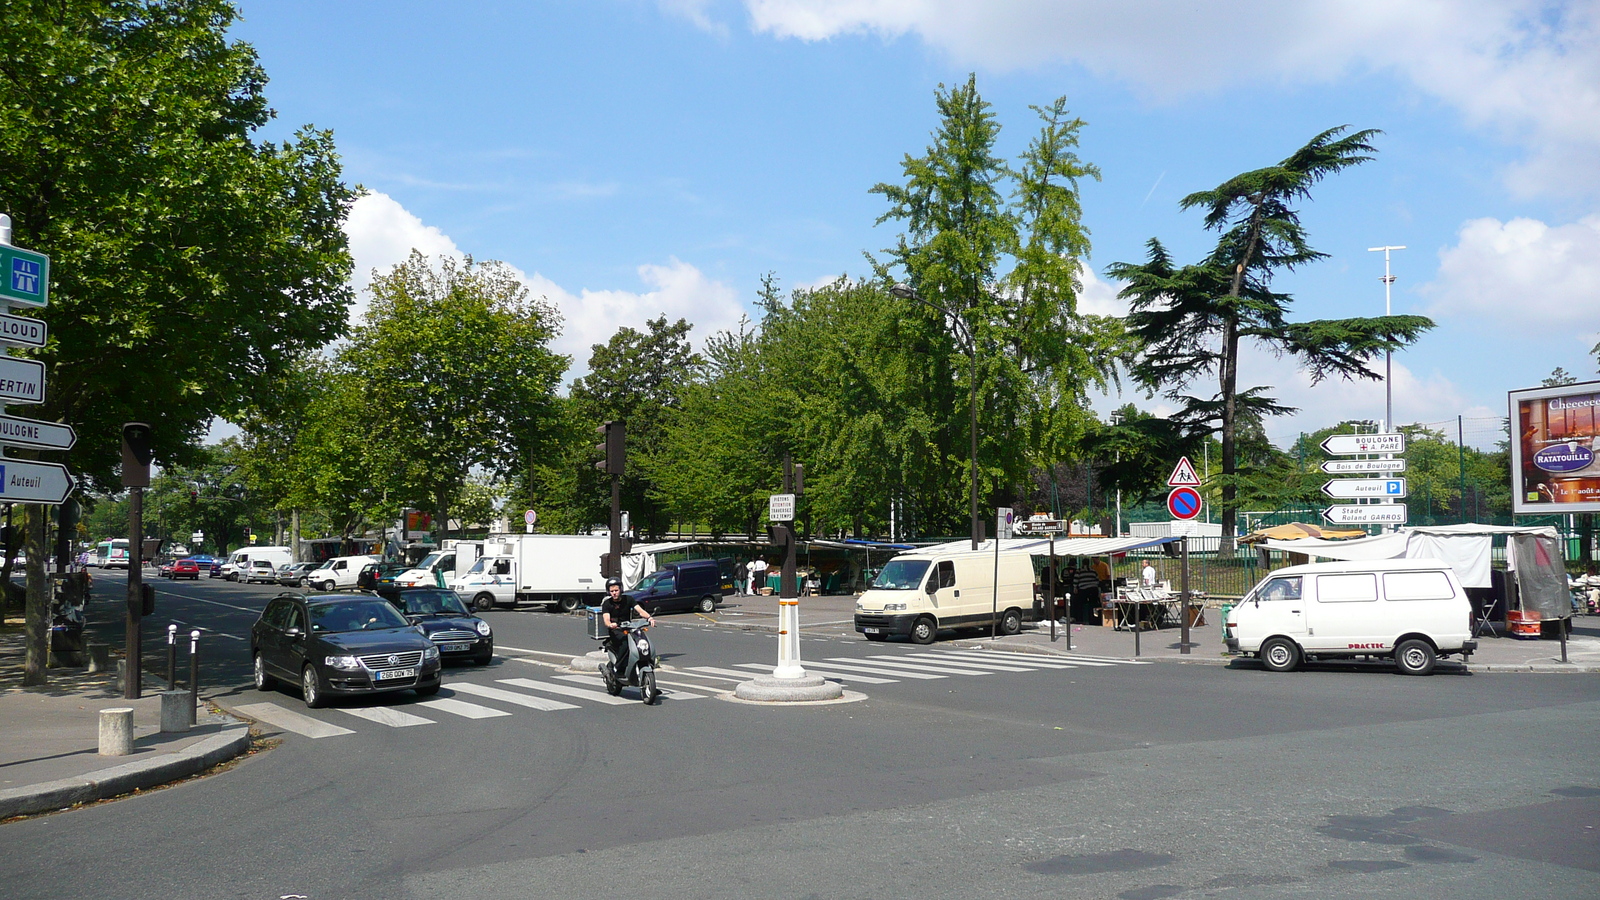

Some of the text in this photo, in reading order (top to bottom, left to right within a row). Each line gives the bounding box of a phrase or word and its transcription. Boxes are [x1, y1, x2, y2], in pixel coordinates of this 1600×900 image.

[0, 320, 38, 338] LOUD
[1356, 436, 1399, 444] BOULOGNE
[1537, 454, 1590, 463] RATATOUILLE
[10, 475, 41, 488] Auteuil
